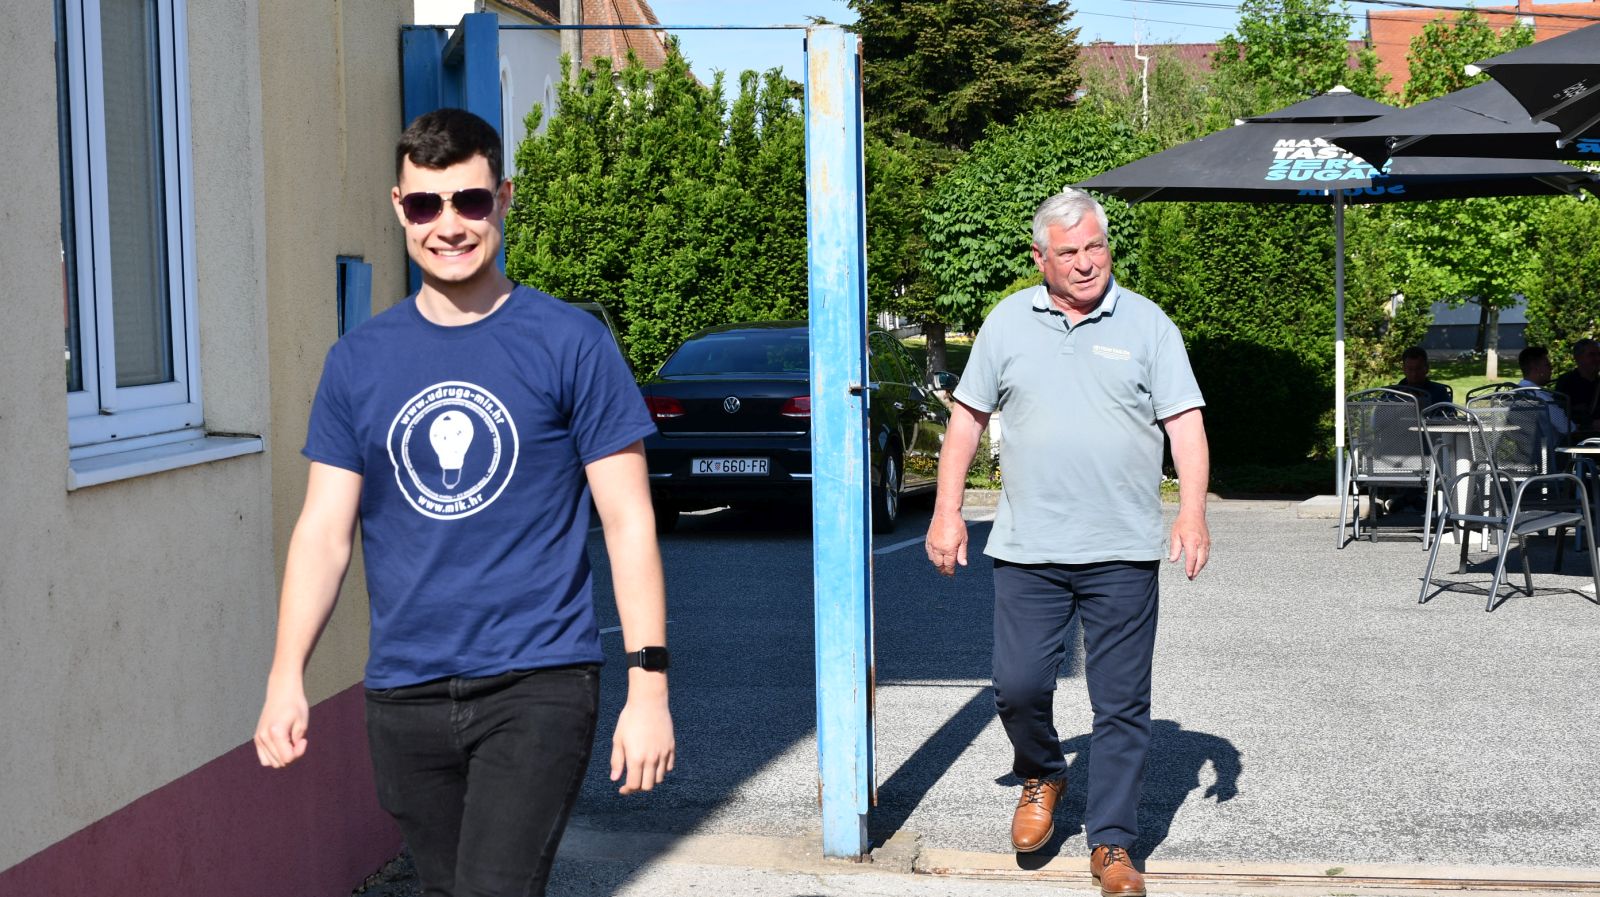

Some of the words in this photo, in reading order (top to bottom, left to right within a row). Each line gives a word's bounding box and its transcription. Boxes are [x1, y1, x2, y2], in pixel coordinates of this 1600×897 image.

[401, 387, 505, 425] www.udruga-mis.hr
[699, 460, 713, 473] CK
[417, 493, 483, 513] www.mik.hr
